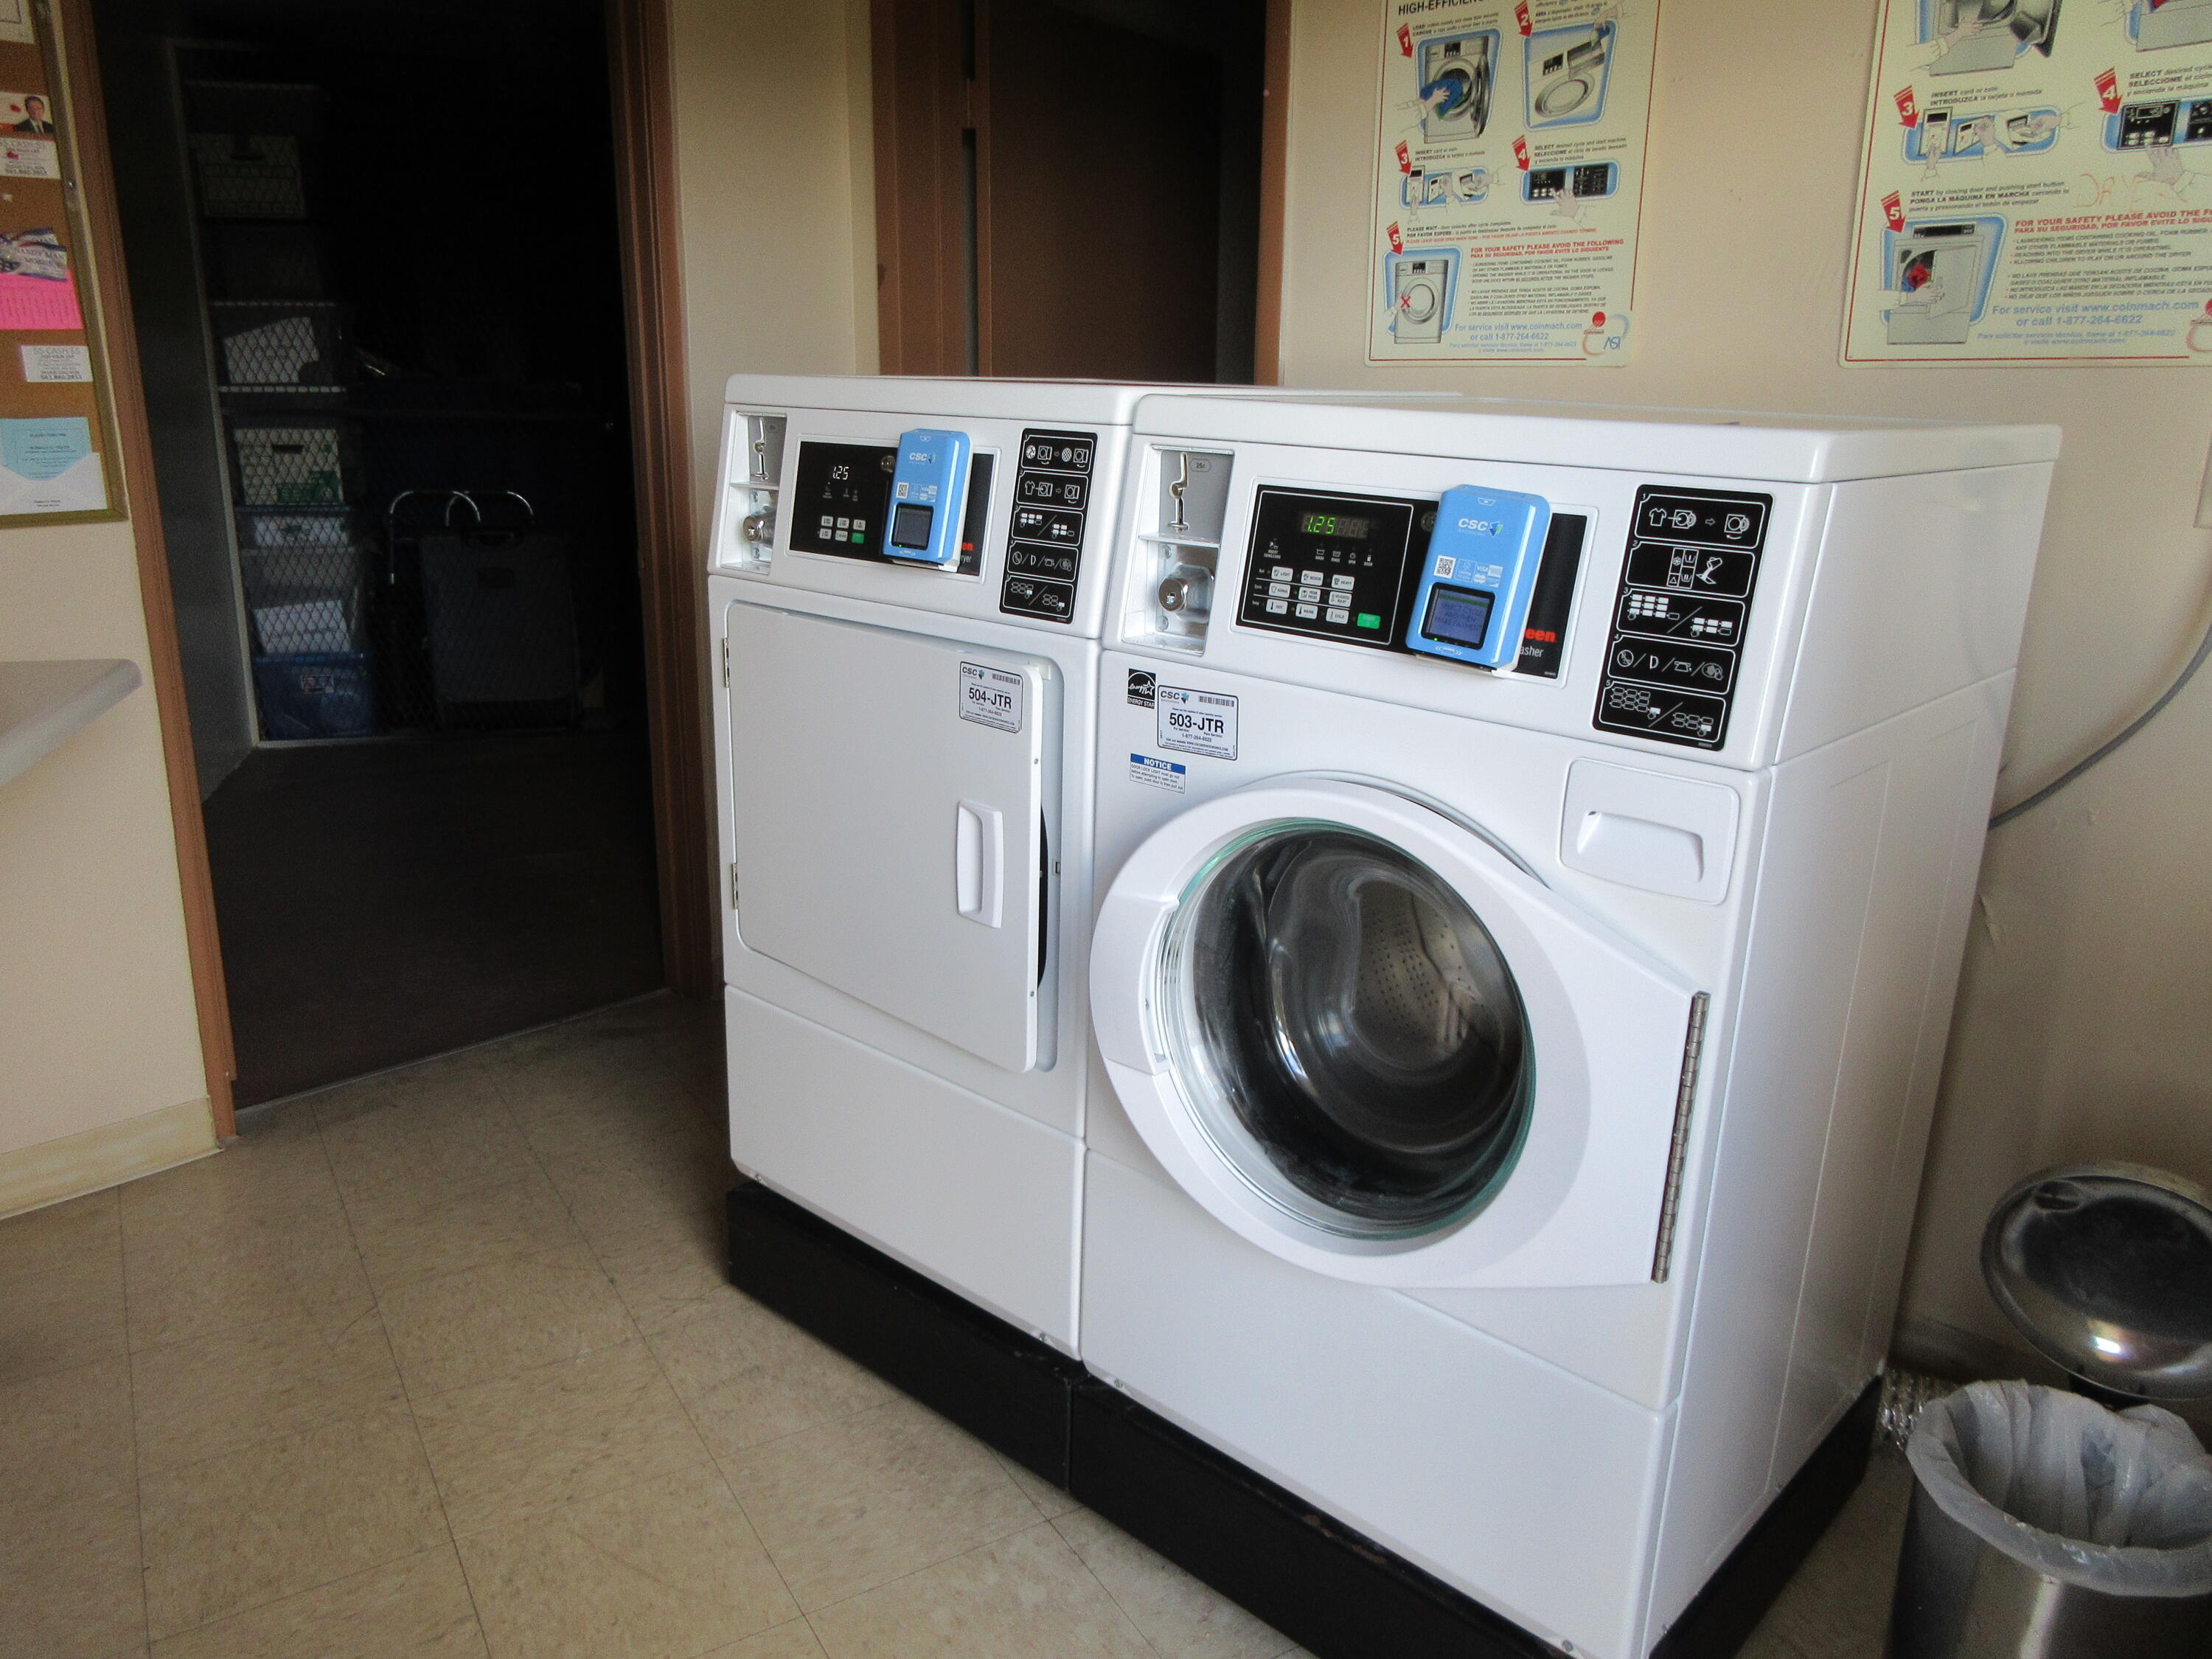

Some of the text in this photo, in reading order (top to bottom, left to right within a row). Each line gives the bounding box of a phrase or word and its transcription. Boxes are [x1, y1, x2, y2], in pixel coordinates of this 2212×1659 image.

[1520, 14, 1528, 26] 2
[2129, 70, 2162, 79] SELECT
[2102, 84, 2117, 100] 4
[1902, 101, 1914, 116] 3
[1401, 153, 1408, 164] 3
[1518, 148, 1528, 160] 4
[1889, 206, 1900, 220] 5
[2037, 218, 2062, 226] YOUR
[2106, 213, 2144, 221] PLEASE
[1391, 234, 1399, 246] 5
[1587, 238, 1624, 246] FOLLOWING
[1992, 299, 2199, 315] For service visit www.coinmach.com
[1455, 321, 1582, 331] For service visit www.coinmach.com
[2016, 314, 2143, 327] or call 1-877-264-6622
[1480, 333, 1493, 341] call
[1495, 332, 1549, 341] 1-877-264-6622
[909, 452, 928, 462] CSC
[1307, 516, 1338, 535] 1.25
[1458, 518, 1489, 532] CSC
[961, 542, 974, 552] en
[961, 554, 972, 563] ryer
[1525, 627, 1555, 642] een
[1520, 646, 1544, 658] asher
[962, 667, 978, 676] CSC
[969, 687, 1012, 709] 504-JTR
[1161, 690, 1180, 700] CSC
[1127, 697, 1155, 709] ENERGY STAR
[1169, 712, 1224, 734] 503-JTR
[1144, 757, 1172, 771] NOTICE
